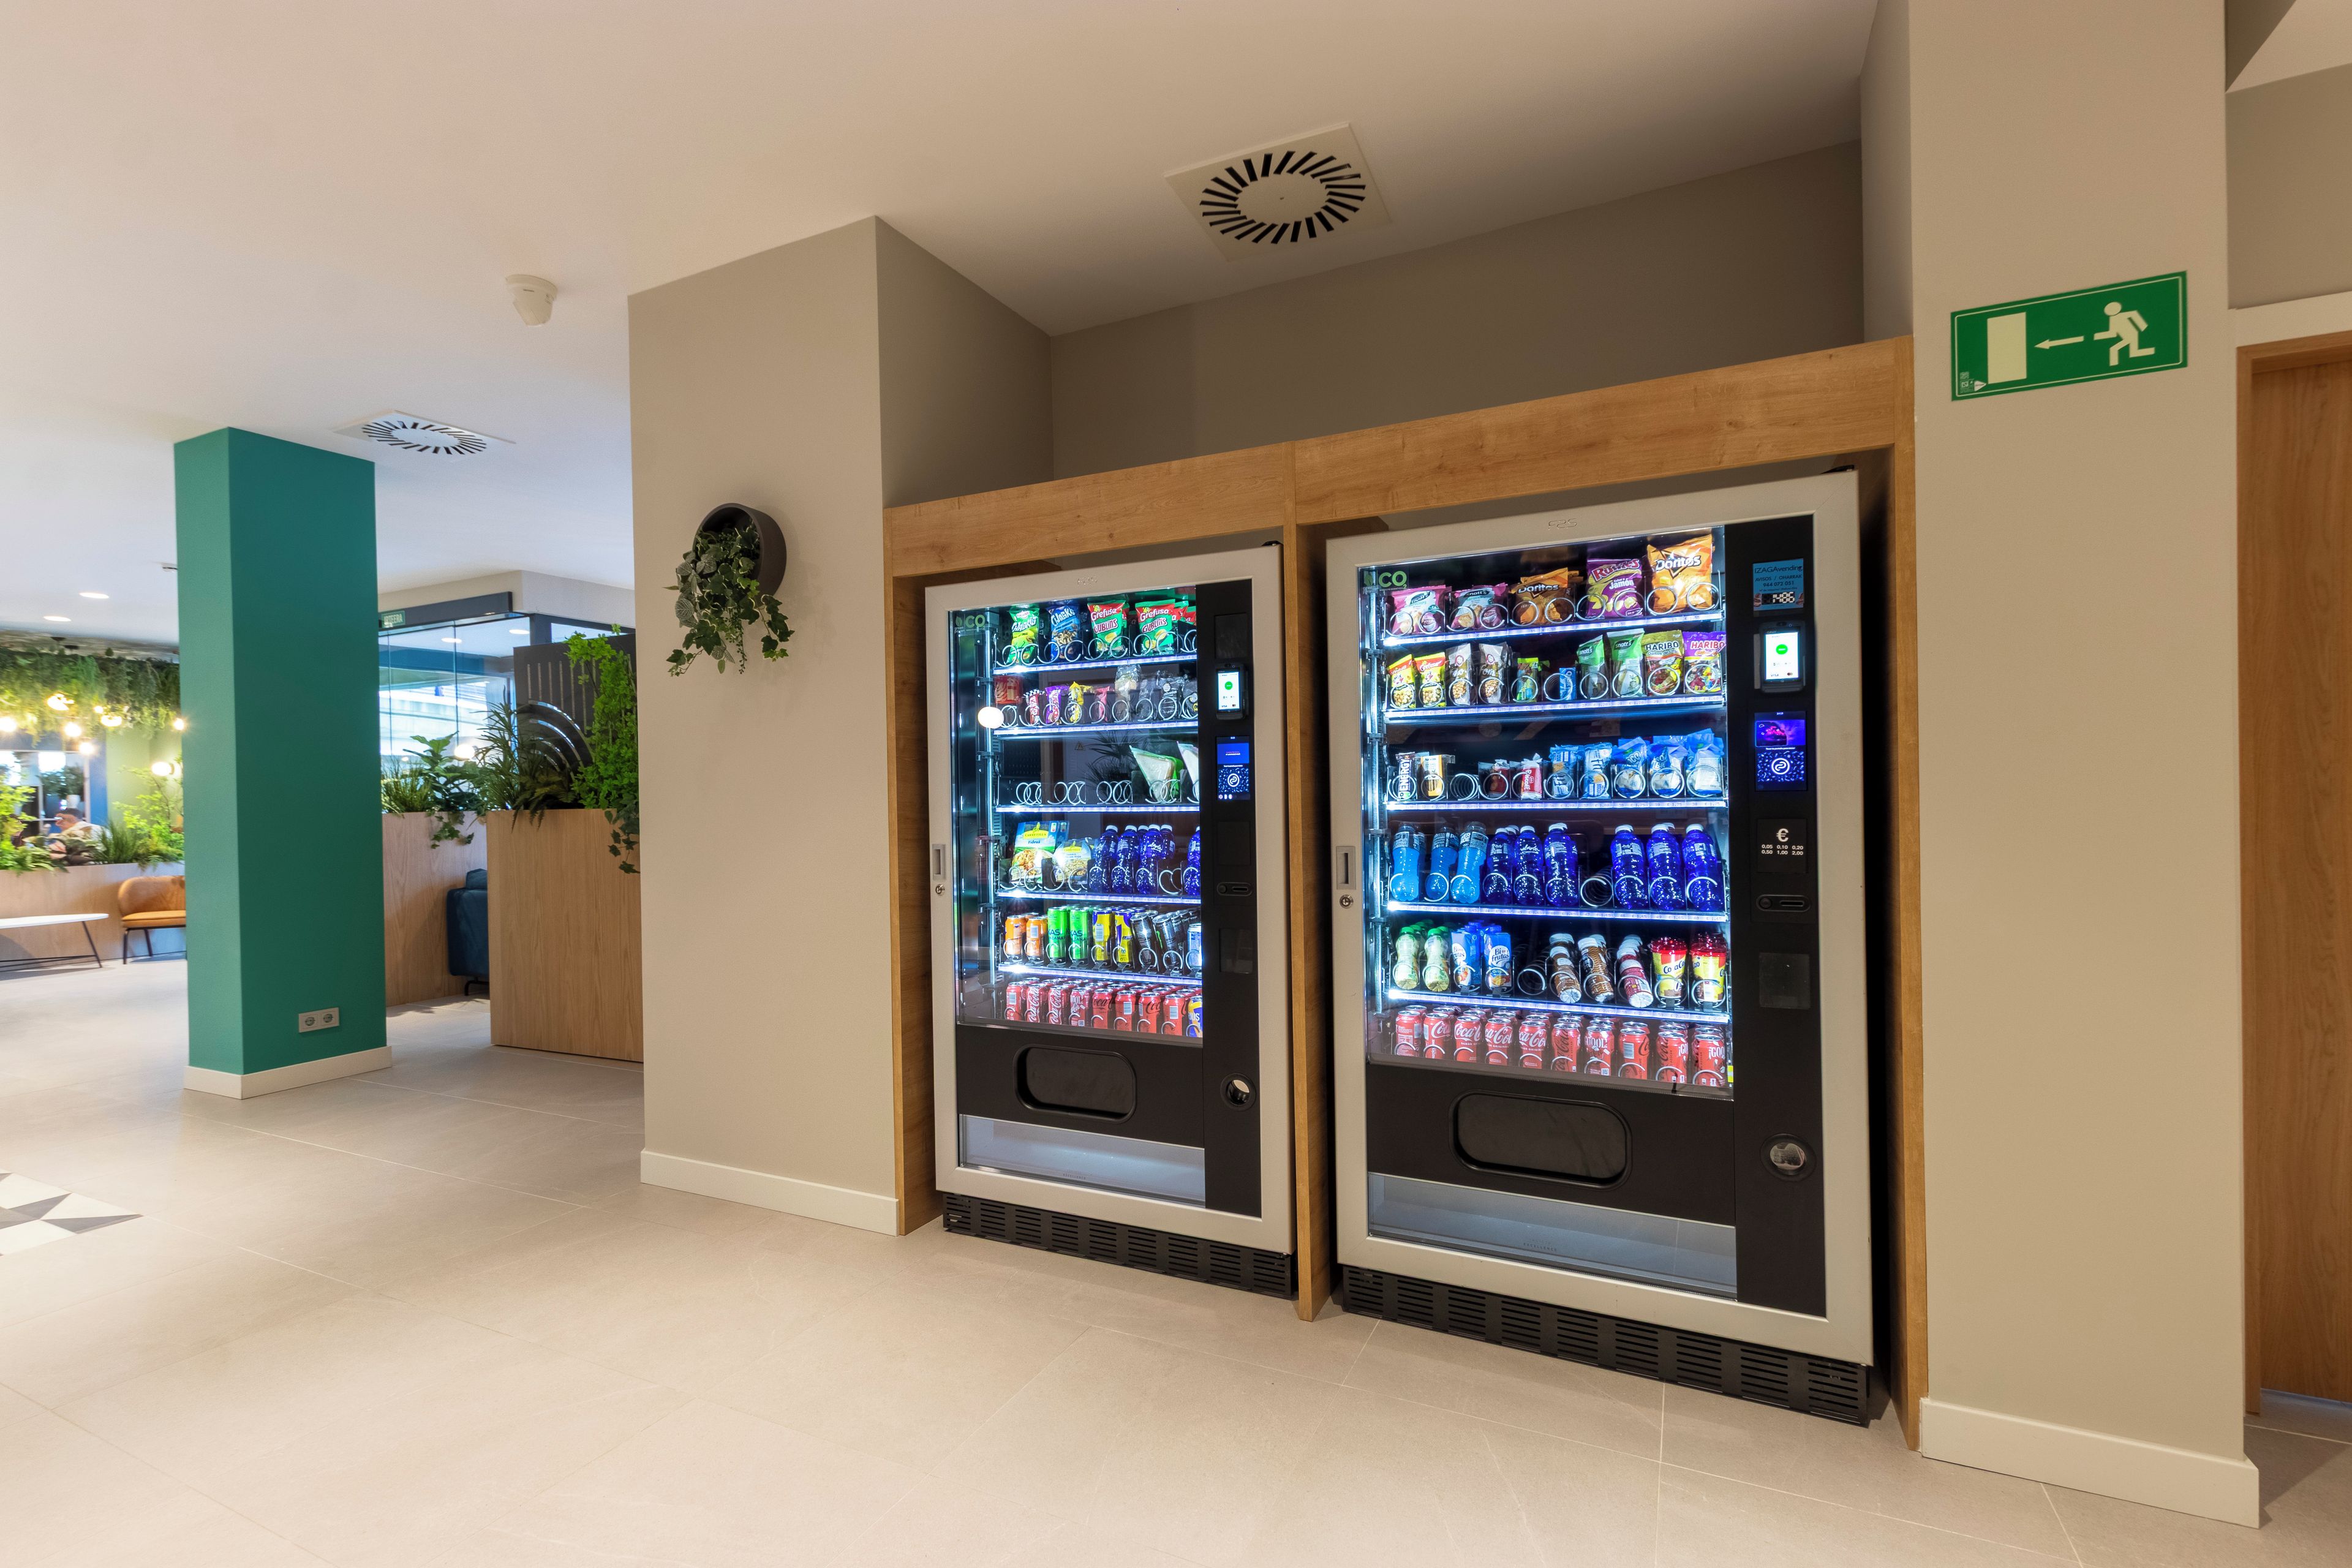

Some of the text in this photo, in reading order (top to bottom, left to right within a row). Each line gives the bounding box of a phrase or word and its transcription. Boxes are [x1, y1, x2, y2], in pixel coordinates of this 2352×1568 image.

[1655, 556, 1701, 570] Doritos
[1591, 559, 1640, 582] Ruffles
[1754, 565, 1803, 574] IZAGAvending
[1517, 584, 1559, 594] Doritos
[1609, 578, 1634, 590] Jamón
[1090, 607, 1117, 621] Grefusa
[1140, 609, 1169, 621] Grefusa
[1645, 641, 1679, 651] HARIBO
[1691, 641, 1725, 650] HARIBO
[1776, 828, 1789, 842] €
[1454, 1023, 1481, 1041] Coca-C
